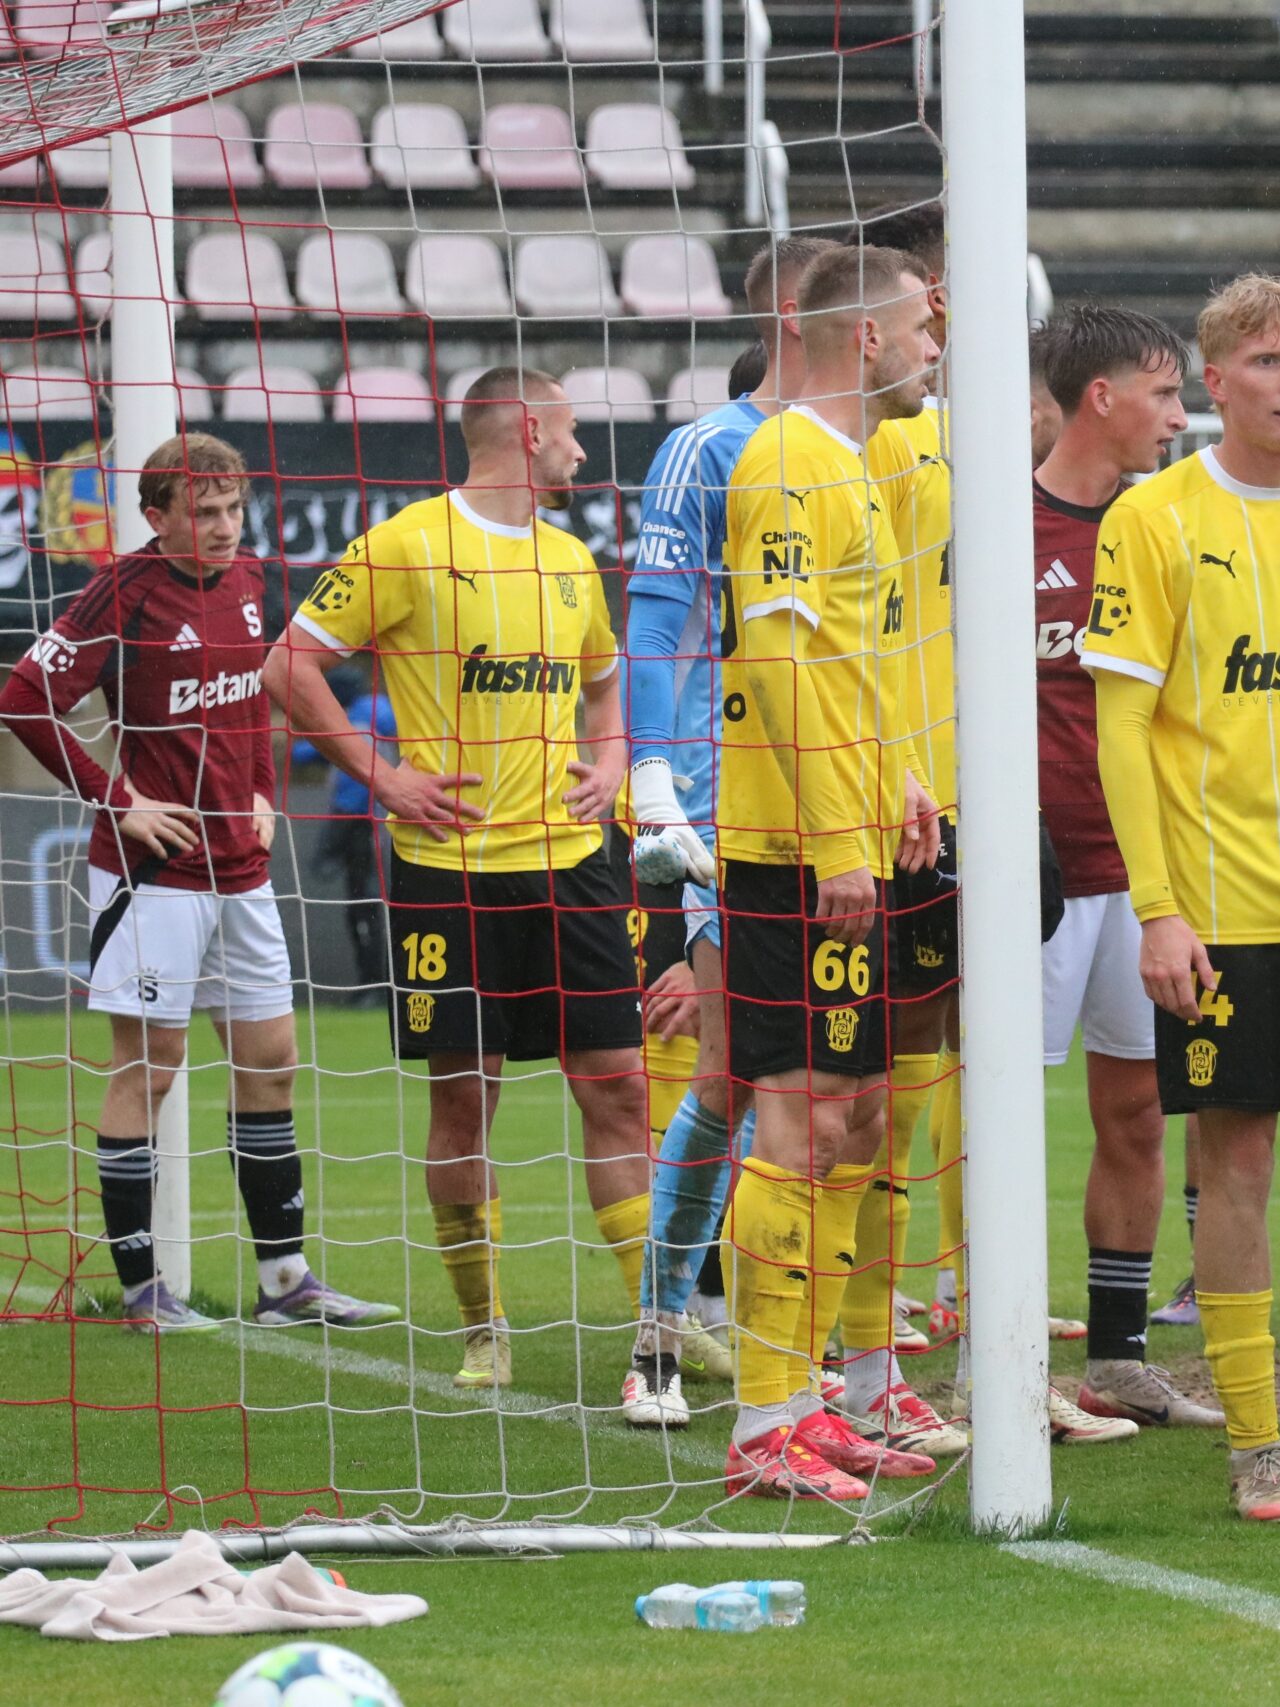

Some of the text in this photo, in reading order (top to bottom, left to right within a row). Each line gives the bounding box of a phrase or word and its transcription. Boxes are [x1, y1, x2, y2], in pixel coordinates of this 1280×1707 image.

[642, 521, 686, 540] Chance
[760, 530, 812, 549] Chance
[241, 602, 262, 638] S
[461, 643, 576, 694] fastav
[402, 932, 447, 982] 18
[812, 939, 870, 997] 66
